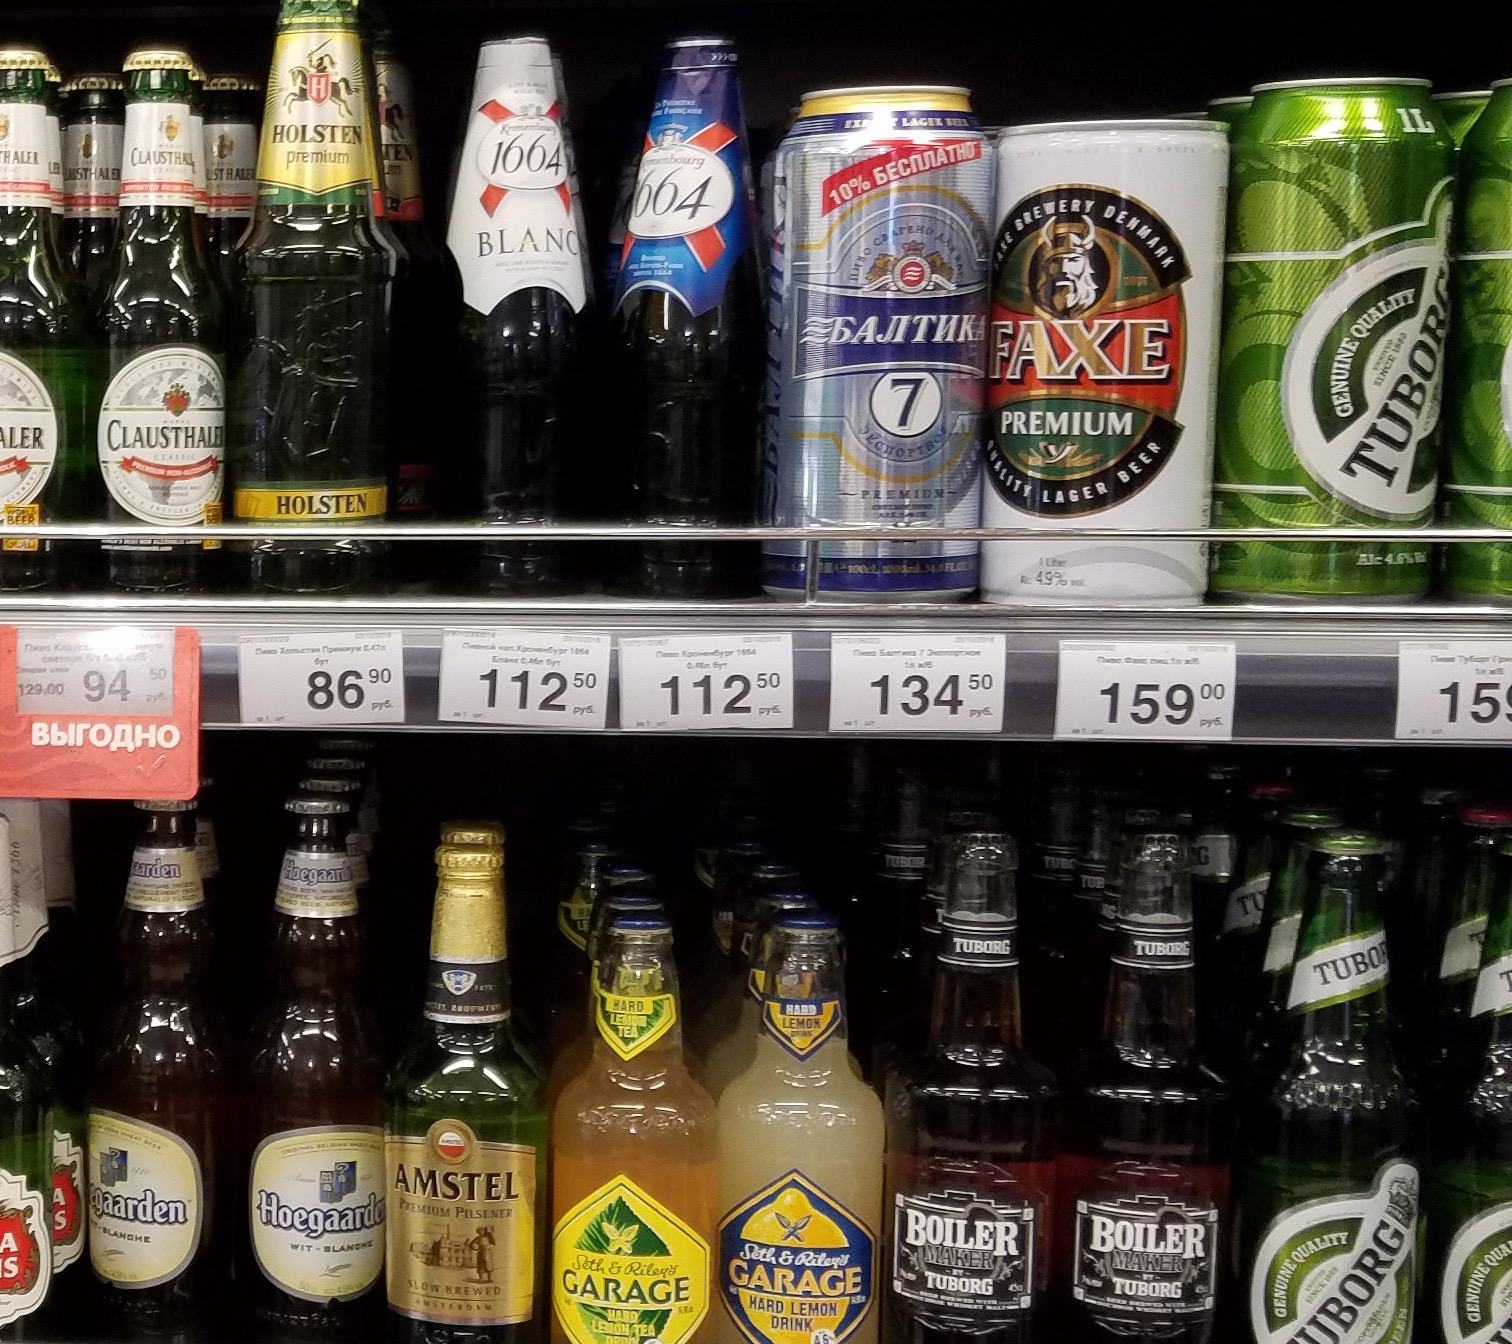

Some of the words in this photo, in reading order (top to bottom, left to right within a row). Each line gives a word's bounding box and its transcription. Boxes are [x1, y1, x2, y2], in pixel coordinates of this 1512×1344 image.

[273, 125, 362, 146] HOLSTEN
[287, 149, 350, 170] premium
[491, 134, 562, 176] 1664
[988, 319, 1171, 379] FAXE
[1001, 412, 1133, 435] PREMIUM
[276, 492, 368, 516] HOLSTEN
[307, 668, 364, 710] 86
[369, 667, 392, 686] 90
[479, 670, 566, 712] 112
[573, 672, 597, 690] 50
[870, 674, 963, 717] 134
[968, 674, 993, 690] 50
[30, 722, 180, 750] ВЫГОДНО
[953, 936, 1010, 955] TUBORG
[394, 1163, 519, 1202] AMSTEL
[906, 1209, 1019, 1256] BOILER
[1091, 1215, 1206, 1259] BOILER
[562, 1269, 690, 1304] GARAGE
[728, 1258, 863, 1297] GARAGE
[925, 1272, 993, 1295] TUBORG
[1113, 1278, 1182, 1298] TUBORG
[749, 1296, 784, 1315] HARD
[791, 1298, 837, 1317] LEMON
[771, 1316, 813, 1332] DRINK
